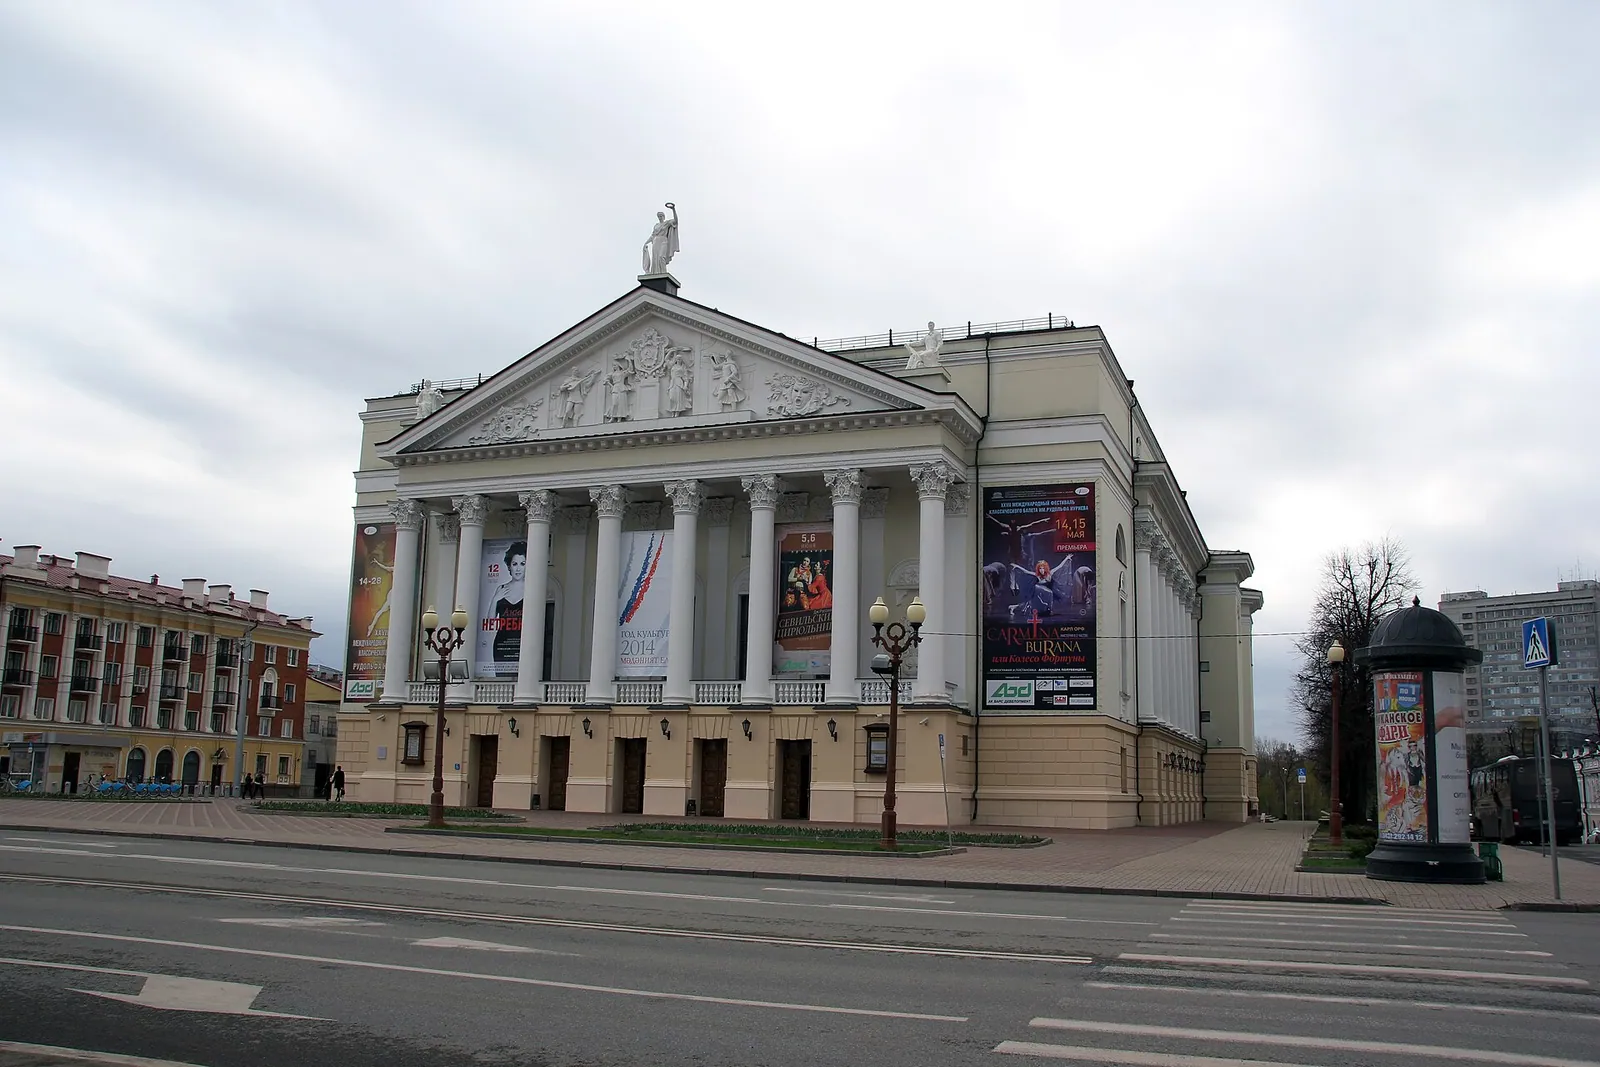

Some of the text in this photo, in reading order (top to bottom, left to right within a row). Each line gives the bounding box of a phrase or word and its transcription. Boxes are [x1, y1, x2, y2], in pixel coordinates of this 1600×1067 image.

[1056, 518, 1086, 531] 14,15
[1067, 531, 1085, 539] МАЯ
[488, 564, 499, 573] 12
[359, 577, 382, 586] 14-28
[779, 613, 832, 628] СЕВИЛЬСКИ
[621, 630, 670, 639] ГОД КУЛЬТУР
[620, 639, 655, 656] 2014
[1026, 640, 1081, 656] BURANA
[992, 654, 1086, 664] или Колесо Фортуны
[1378, 725, 1411, 742] ФАРИ
